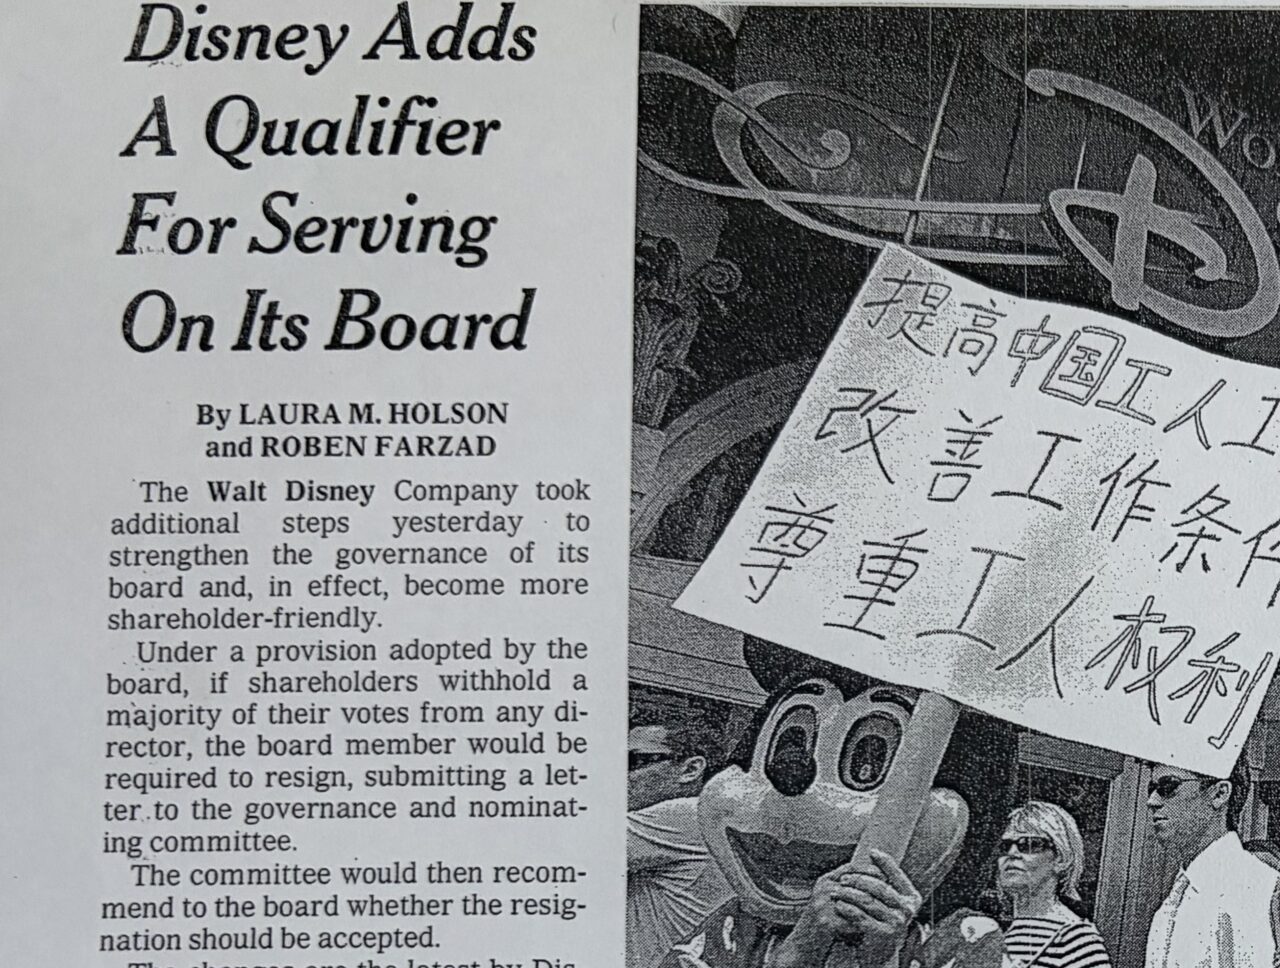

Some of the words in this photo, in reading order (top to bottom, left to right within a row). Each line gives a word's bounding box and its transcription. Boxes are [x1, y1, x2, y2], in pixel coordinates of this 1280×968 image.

[123, 2, 350, 77] Disney
[361, 0, 538, 62] Adds
[118, 94, 178, 158] A
[204, 93, 502, 171] Qualifier
[115, 190, 238, 256] For
[246, 189, 499, 269] Serving
[121, 288, 215, 354] On
[229, 288, 310, 352] Its
[323, 287, 538, 352] Board
[195, 403, 232, 432] By
[238, 402, 342, 426] LAURA
[348, 402, 382, 425] M.
[387, 401, 510, 425] HOLSON
[205, 435, 253, 458] and
[260, 435, 368, 458] ROBEN
[374, 435, 497, 458] FARZAD
[138, 480, 189, 504] The
[206, 479, 268, 503] Walt
[284, 479, 376, 508] Disney
[393, 478, 519, 507] Company
[535, 478, 591, 501] took
[110, 511, 240, 536] additional
[282, 513, 350, 539] steps
[391, 510, 524, 539] yesterday
[565, 512, 591, 533] to
[739, 492, 1273, 750] 尊重工人权利
[99, 928, 182, 952] nation
[188, 926, 274, 951] should
[280, 926, 311, 950] be
[317, 924, 441, 955] accepted.
